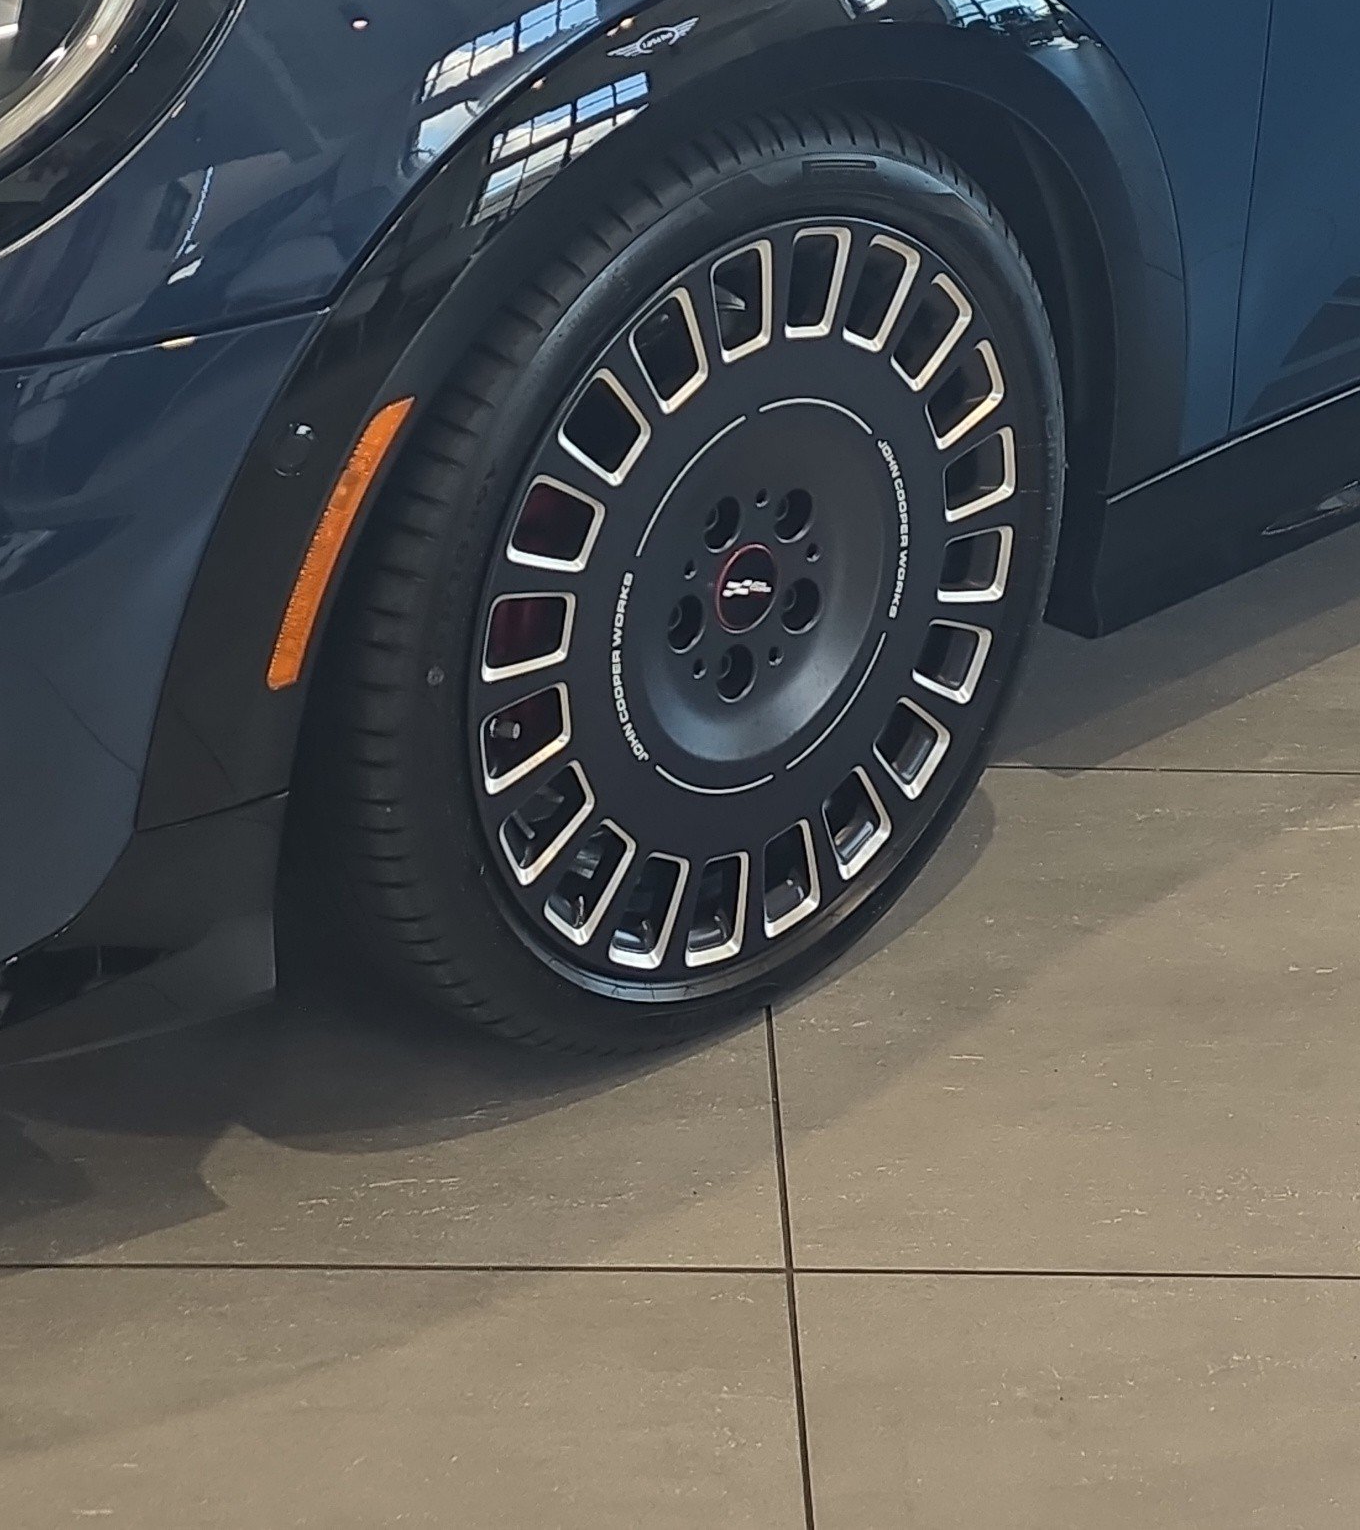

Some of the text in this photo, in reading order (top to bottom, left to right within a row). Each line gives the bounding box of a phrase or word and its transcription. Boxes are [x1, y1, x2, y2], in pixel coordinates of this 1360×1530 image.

[877, 439, 909, 619] JOHN COOPER WORKS
[611, 571, 650, 761] JOHN COOPER WORKS
